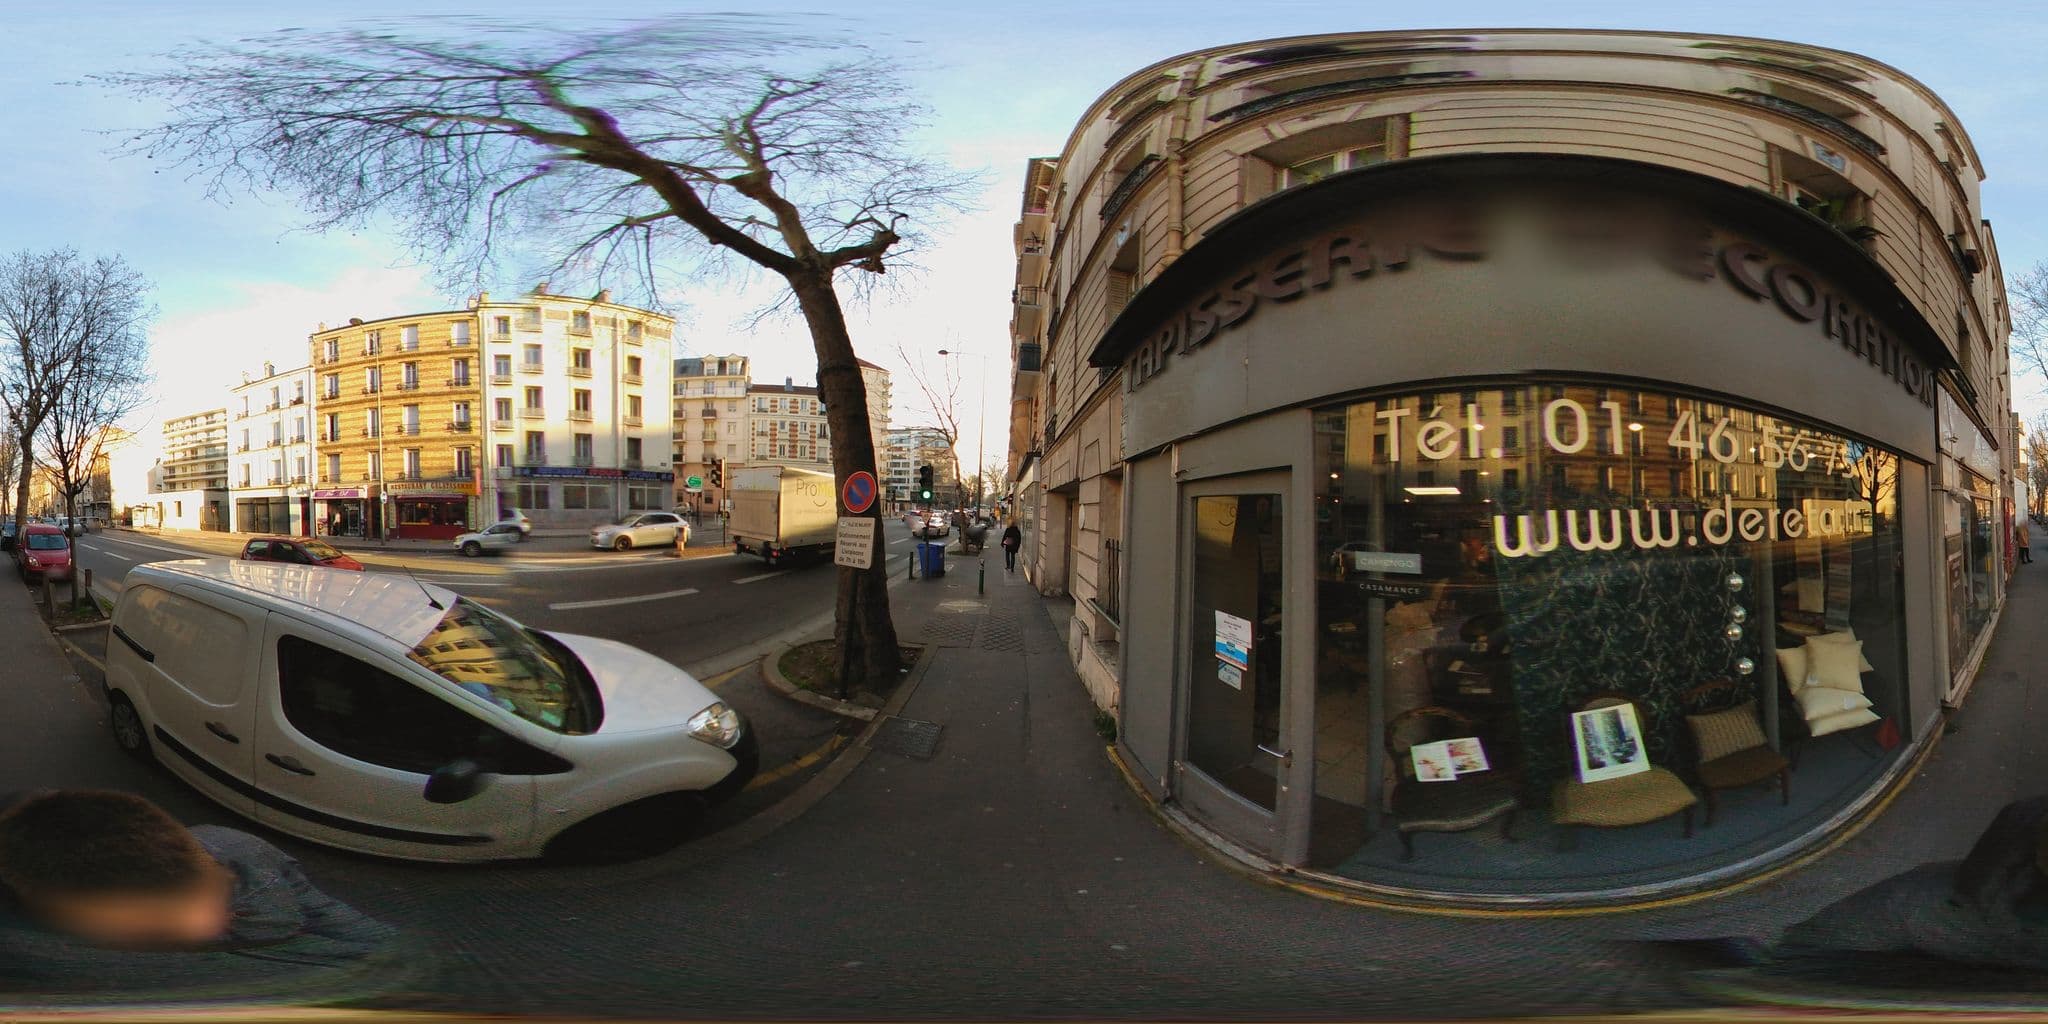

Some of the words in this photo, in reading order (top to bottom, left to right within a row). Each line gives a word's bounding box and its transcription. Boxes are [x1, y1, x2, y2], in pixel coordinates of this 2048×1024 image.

[1375, 405, 1503, 463] Tél.
[1543, 398, 1624, 455] 01
[1667, 410, 1740, 464] 46
[1759, 423, 1809, 473] 56
[1359, 583, 1421, 595] CASAMANCE
